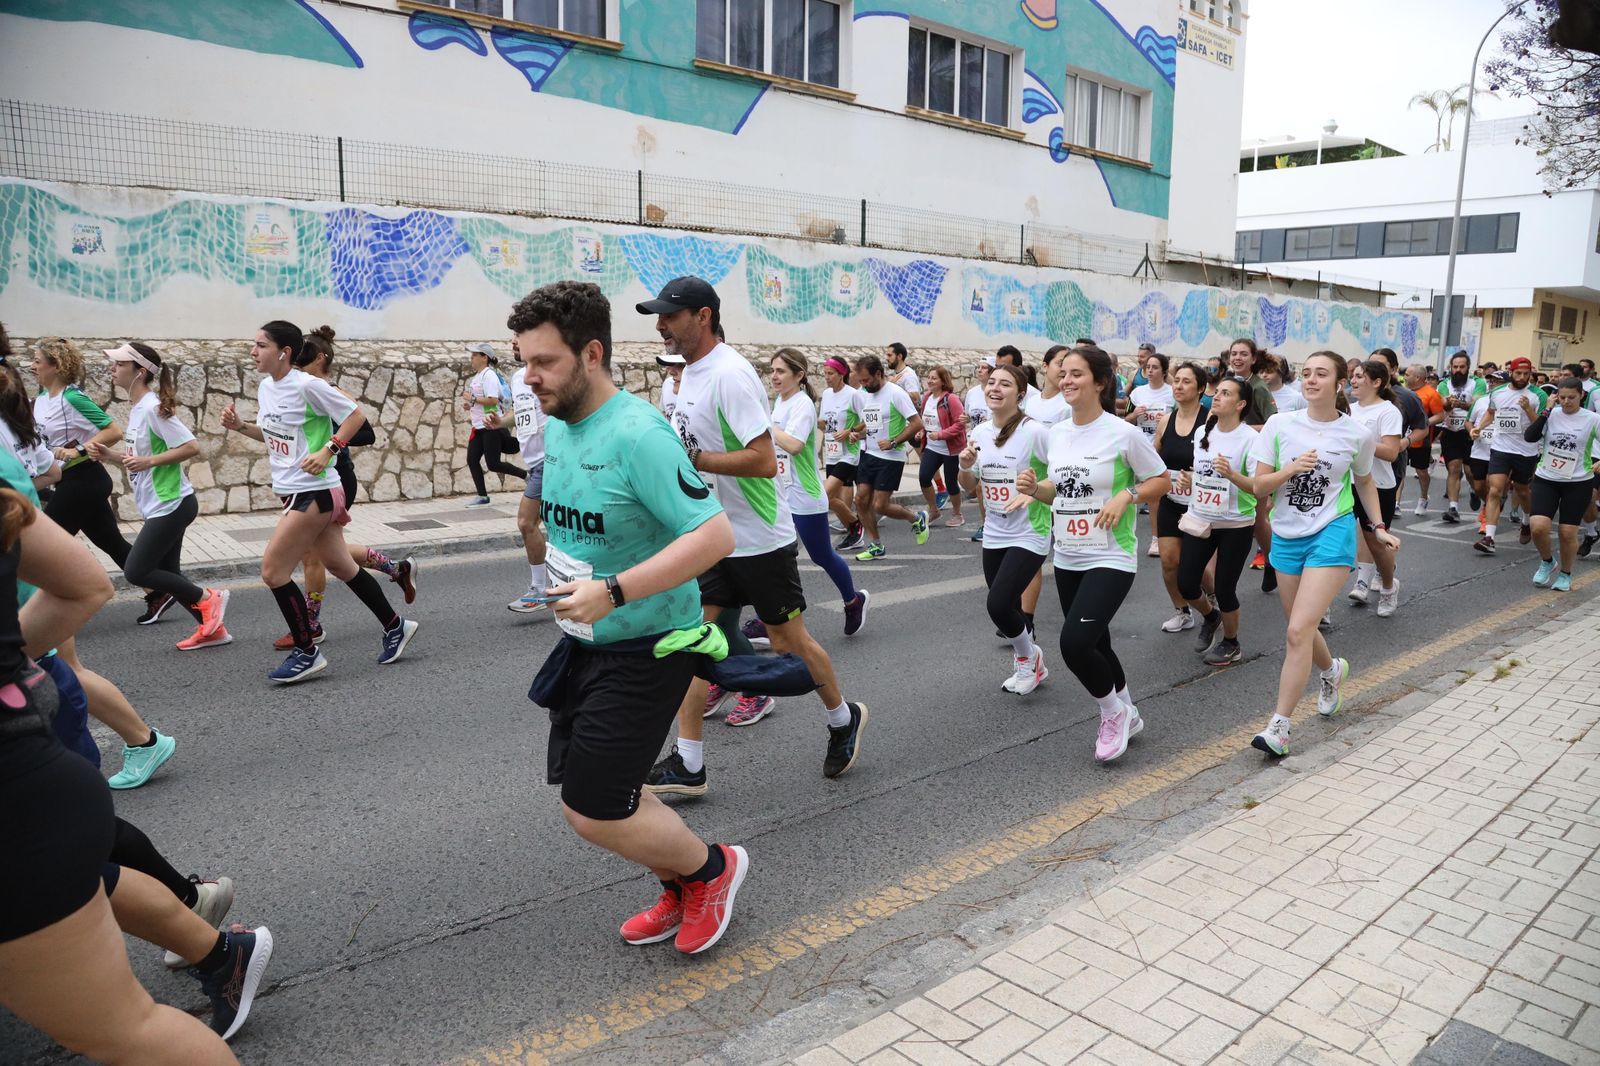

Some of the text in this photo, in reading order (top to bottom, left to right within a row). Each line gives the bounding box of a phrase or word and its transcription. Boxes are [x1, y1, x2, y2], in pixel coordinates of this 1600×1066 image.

[1188, 39, 1207, 56] SAFA
[1216, 50, 1232, 66] ICET
[517, 414, 531, 427] 479
[865, 413, 879, 423] 804
[1499, 419, 1517, 429] 600
[268, 436, 289, 456] 370
[580, 463, 599, 471] FLOWER
[1551, 459, 1566, 469] 57
[984, 485, 1010, 502] 339
[1197, 490, 1221, 506] 374
[1291, 496, 1321, 505] EL PALO
[1066, 518, 1090, 536] 49
[548, 526, 607, 546] ning team
